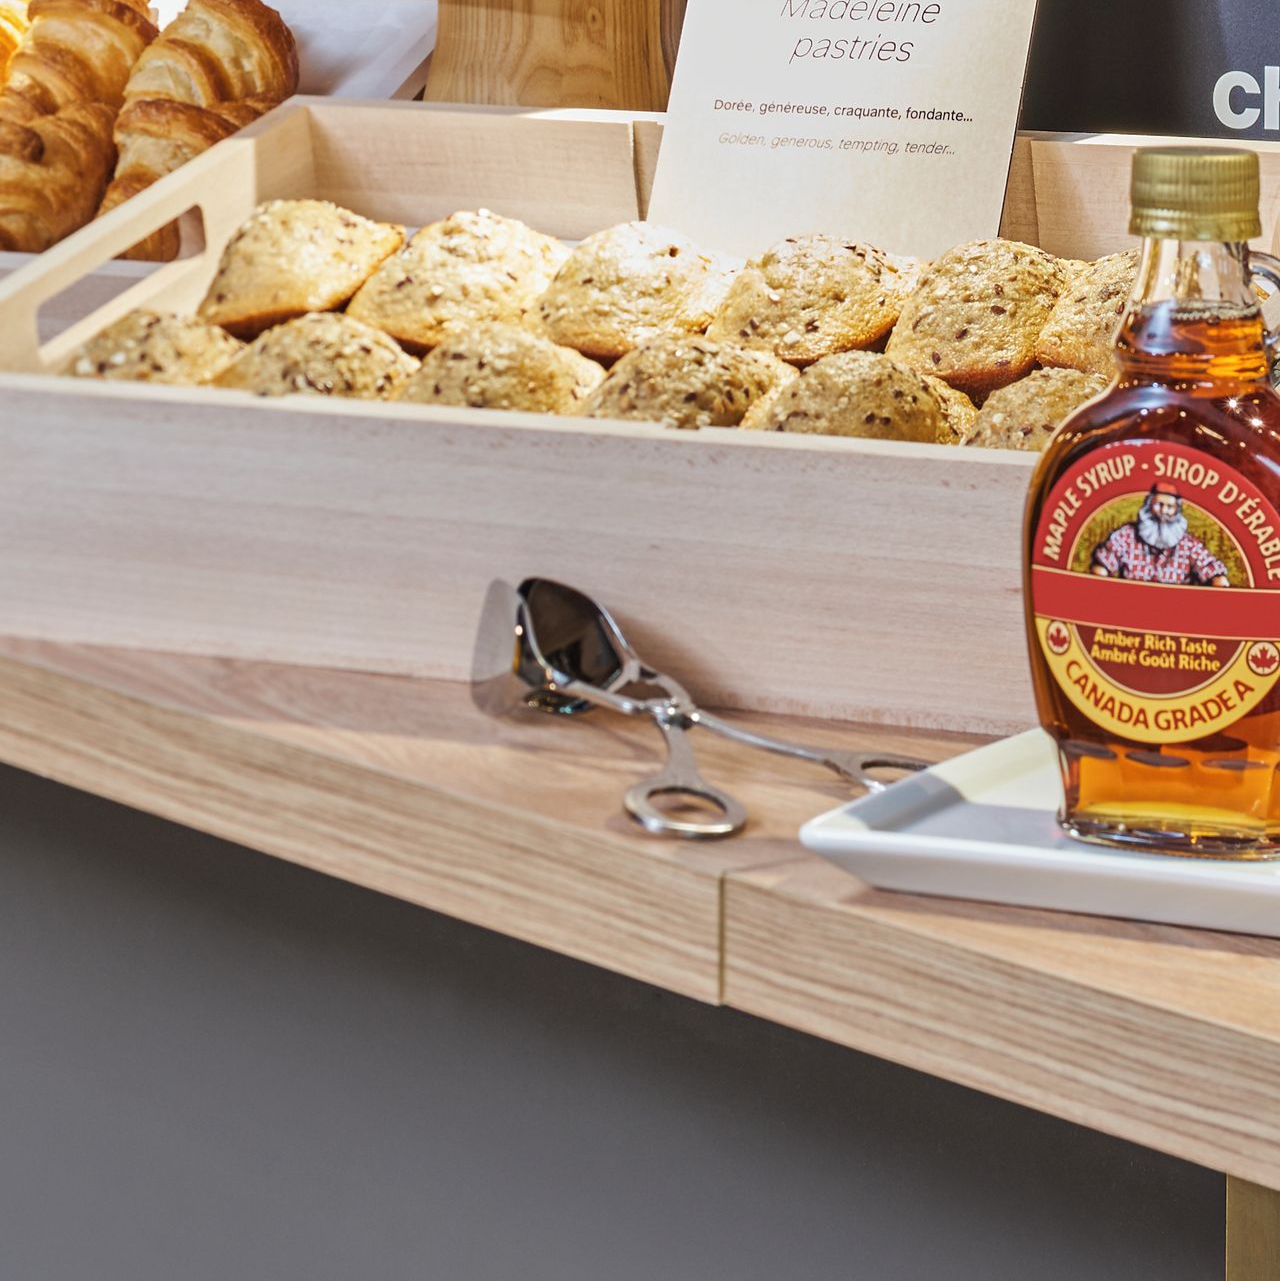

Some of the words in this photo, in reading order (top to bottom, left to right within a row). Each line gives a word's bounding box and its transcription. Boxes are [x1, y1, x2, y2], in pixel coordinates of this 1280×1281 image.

[789, 34, 914, 64] pastries
[714, 99, 755, 114] Dorée,
[759, 101, 830, 117] généreuse,
[834, 104, 902, 122] craquante,
[718, 131, 767, 146] Golden,
[771, 135, 834, 150] generous,
[838, 137, 900, 155] tempting,
[1042, 487, 1083, 562] MAPLE
[1076, 454, 1136, 498] SYRUP
[1154, 453, 1220, 490] SIROP
[1093, 628, 1141, 648] Amber
[1144, 634, 1177, 652] Rich
[1179, 637, 1217, 655] Taste
[1090, 644, 1137, 665] Ambré
[1139, 650, 1176, 668] Goût
[1178, 654, 1222, 672] Riche
[1066, 660, 1150, 729] CANADA
[1154, 690, 1237, 731] GRADE
[1232, 679, 1256, 702] A
